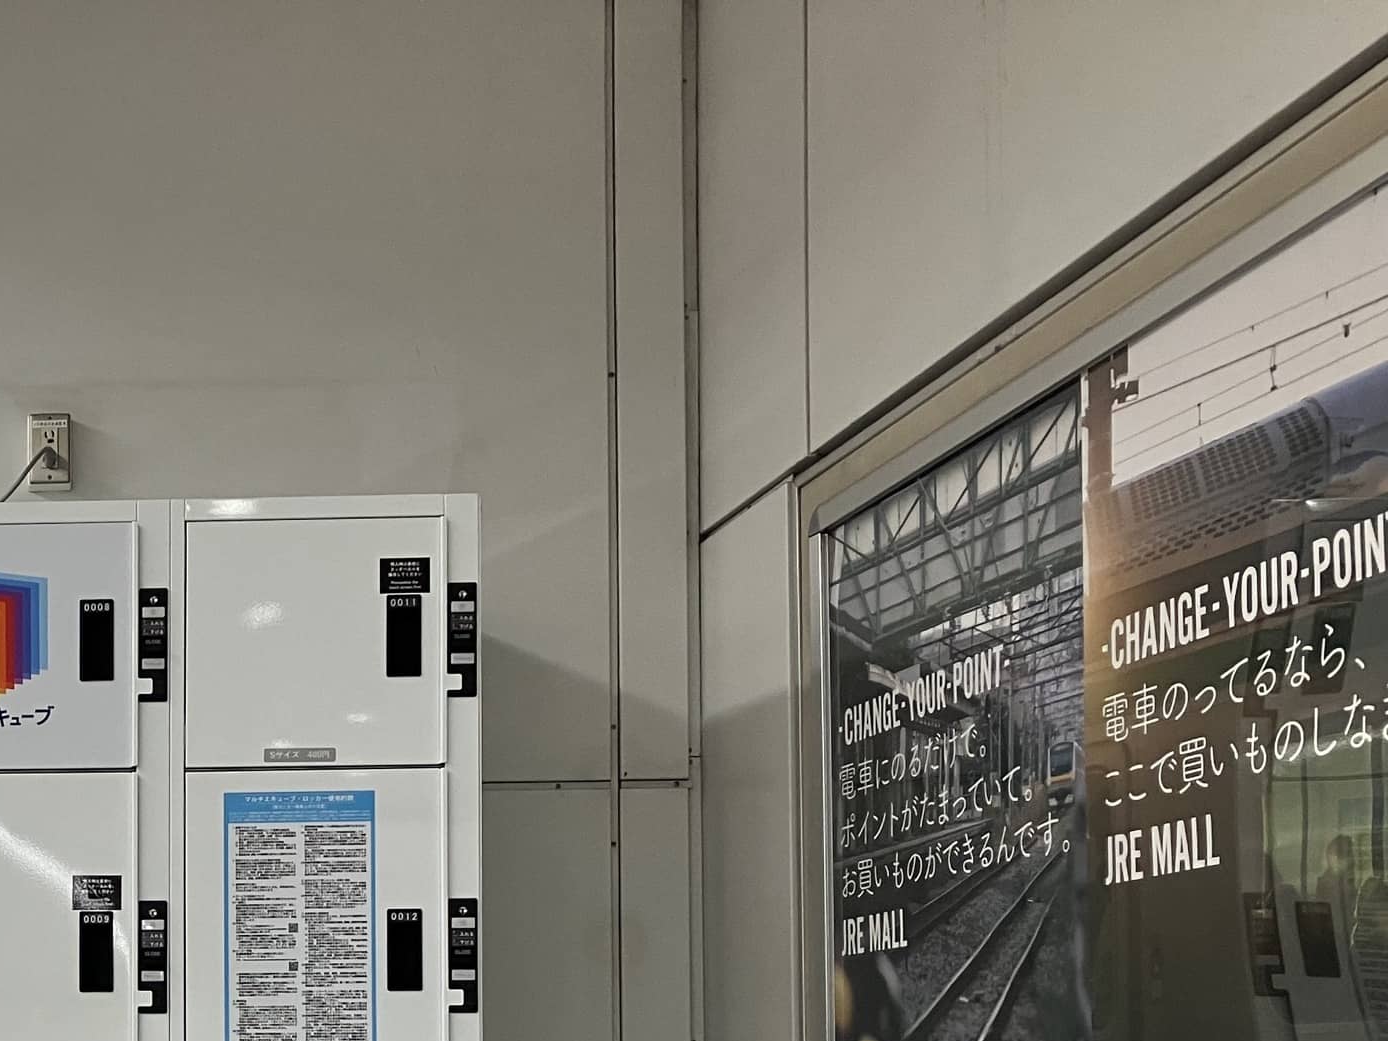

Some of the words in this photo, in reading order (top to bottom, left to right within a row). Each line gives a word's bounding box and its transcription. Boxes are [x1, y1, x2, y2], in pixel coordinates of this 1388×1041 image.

[84, 603, 110, 611] 0008
[390, 598, 417, 607] 0011
[1102, 624, 1366, 743] 電車のってるなら、
[269, 751, 300, 760] Sサイズ
[839, 724, 987, 799] 電車にのるだけで。
[1105, 684, 1388, 807] ここで買いものしな
[840, 766, 1033, 848] ポイントがたまっていて。
[841, 811, 1071, 899] お買いものができるんです。
[1104, 829, 1144, 886] JRE
[1151, 814, 1221, 879] MALL
[83, 915, 110, 923] 0009
[391, 912, 418, 921] 0012
[841, 916, 865, 956] JRE
[869, 908, 908, 952] MALL
